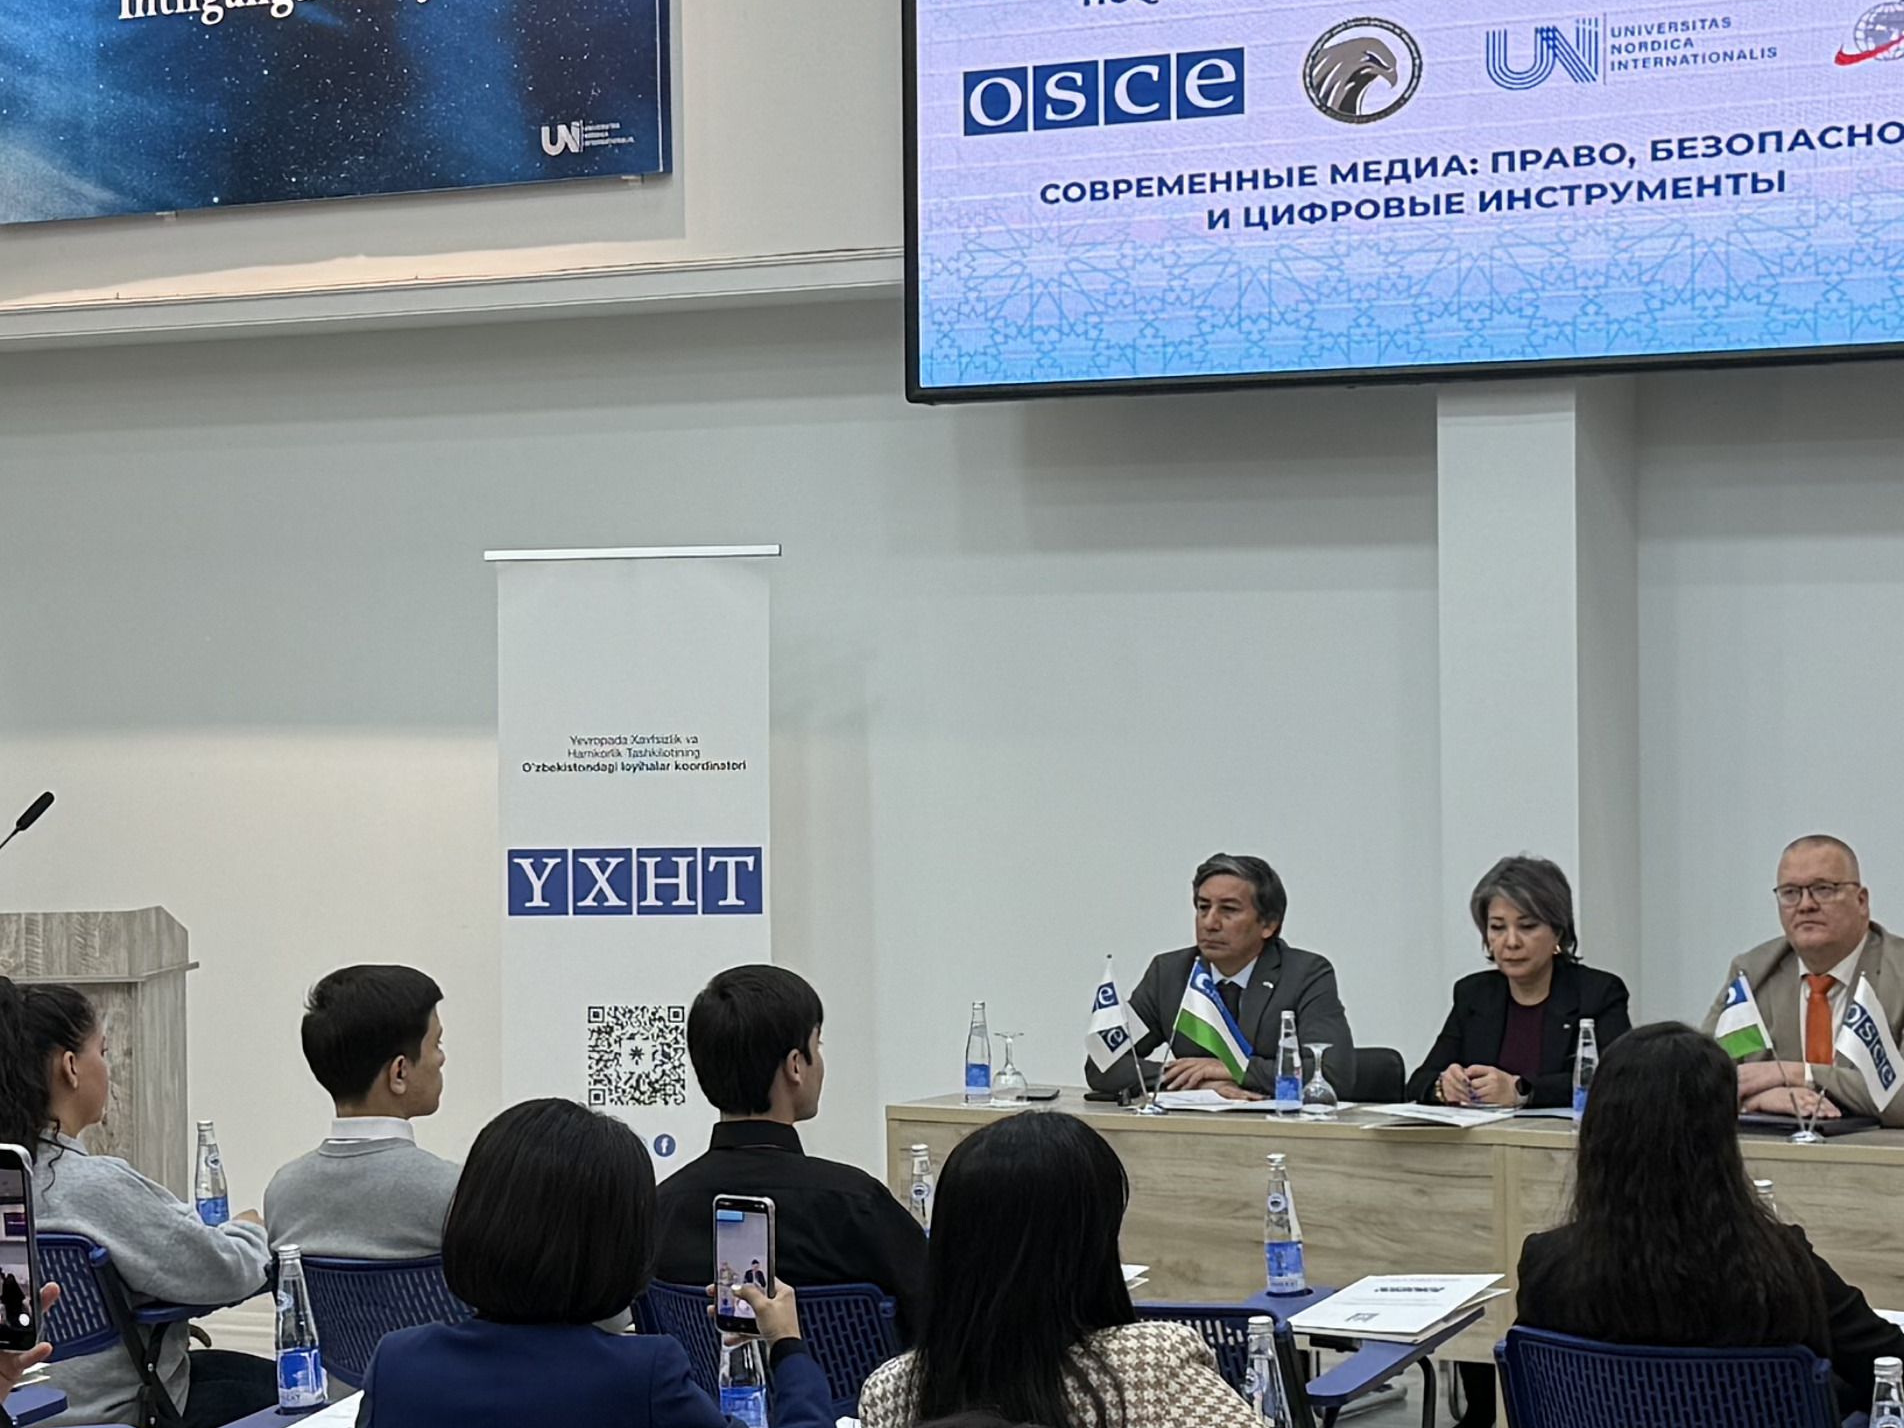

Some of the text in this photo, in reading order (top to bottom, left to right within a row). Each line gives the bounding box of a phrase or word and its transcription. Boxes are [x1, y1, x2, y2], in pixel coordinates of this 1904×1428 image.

[1610, 16, 1733, 39] UNIVERSITAS
[1610, 36, 1695, 55] NORDICA
[1610, 46, 1778, 72] INTERNATIONALIS
[1039, 164, 1319, 205] СОВРЕМЕННЫЕ
[1330, 154, 1480, 185] МЕДИА:
[1491, 142, 1637, 174] ПРАВО,
[1207, 169, 1786, 231] И ЦИФРОВЫЕ ИНСТРУМЕНТЫ
[511, 854, 757, 911] YXHT
